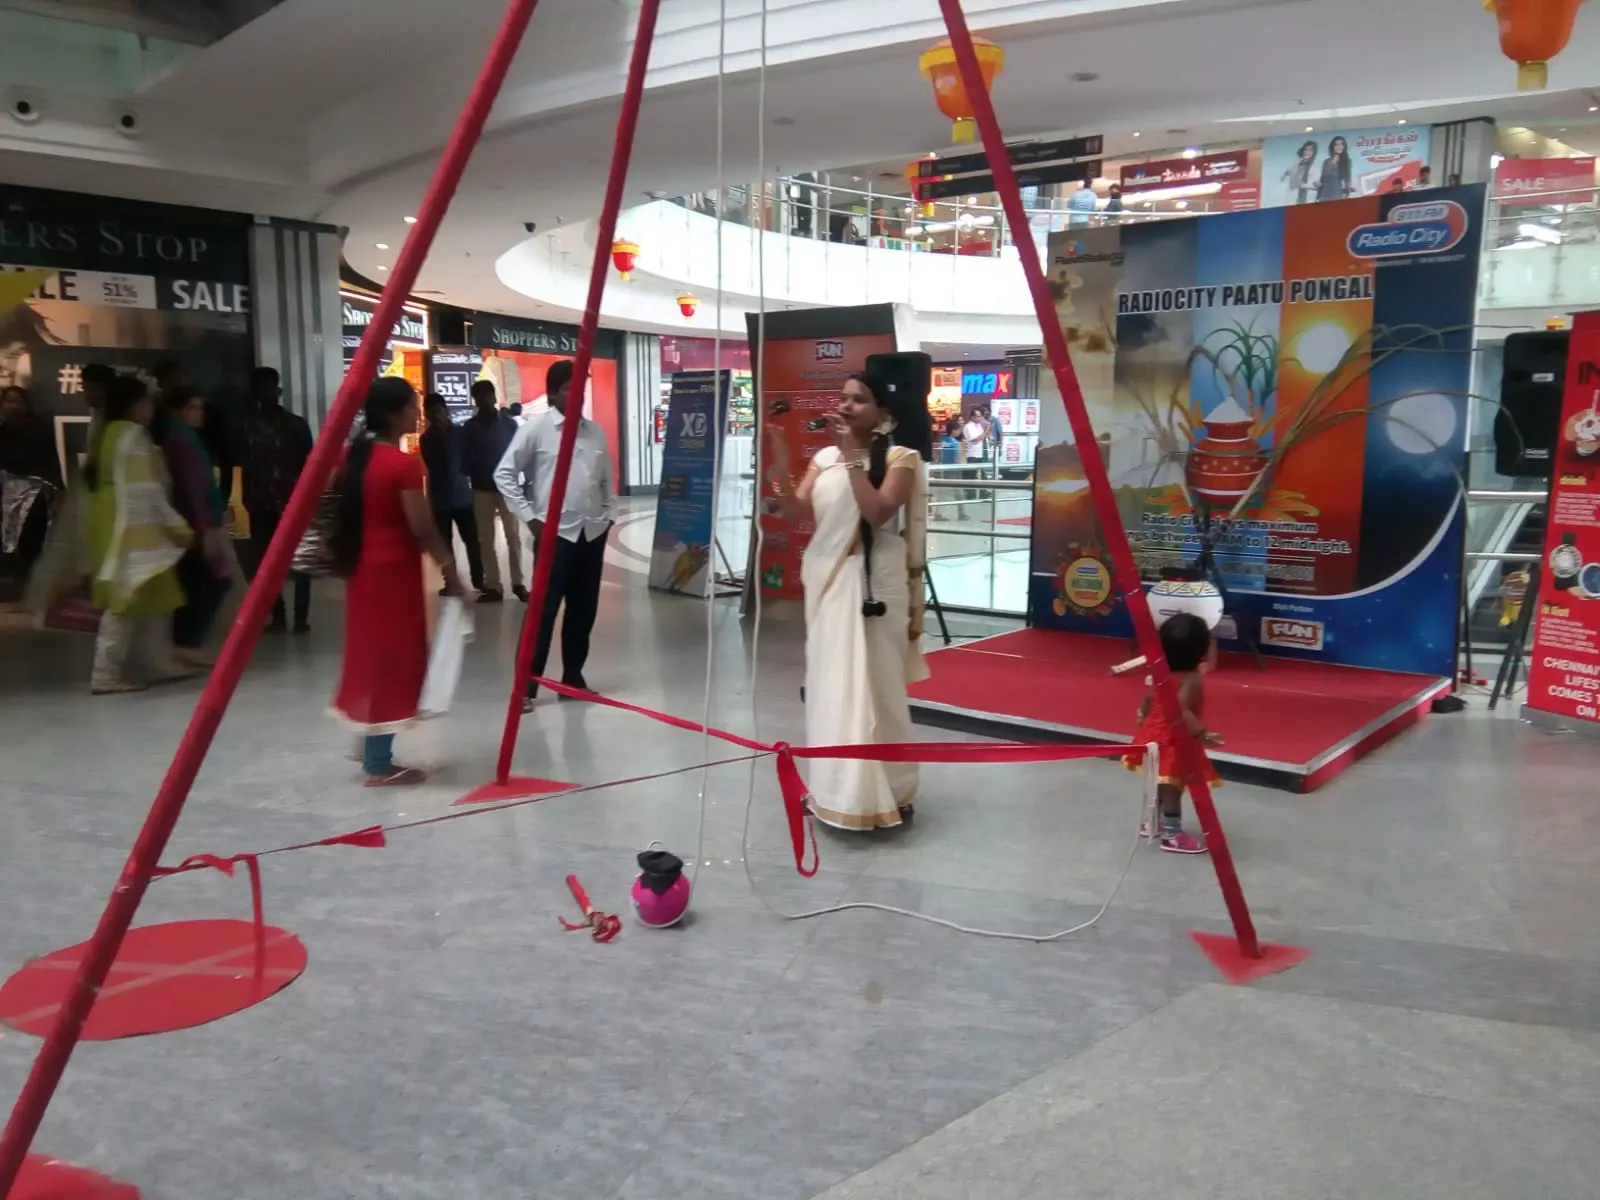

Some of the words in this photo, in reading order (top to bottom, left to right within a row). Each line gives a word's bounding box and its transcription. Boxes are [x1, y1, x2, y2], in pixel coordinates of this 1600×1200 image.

[1502, 177, 1544, 191] SALE
[1357, 230, 1407, 248] Radio
[1409, 228, 1447, 248] City
[103, 281, 138, 299] 51%
[172, 279, 249, 313] SALE
[1118, 286, 1217, 314] RADIOCITY
[1222, 281, 1284, 307] PAATU
[1290, 275, 1373, 303] PONGAL
[492, 327, 557, 350] SHOPPERS
[816, 342, 843, 358] FUN
[438, 382, 467, 396] 51%
[962, 371, 1013, 399] max
[1143, 511, 1177, 525] Radio
[1247, 520, 1318, 534] maximum
[1246, 536, 1261, 548] to
[1264, 536, 1279, 549] 12
[1272, 623, 1313, 638] FUN
[1547, 685, 1593, 703] COMES
[1576, 705, 1597, 718] ON
